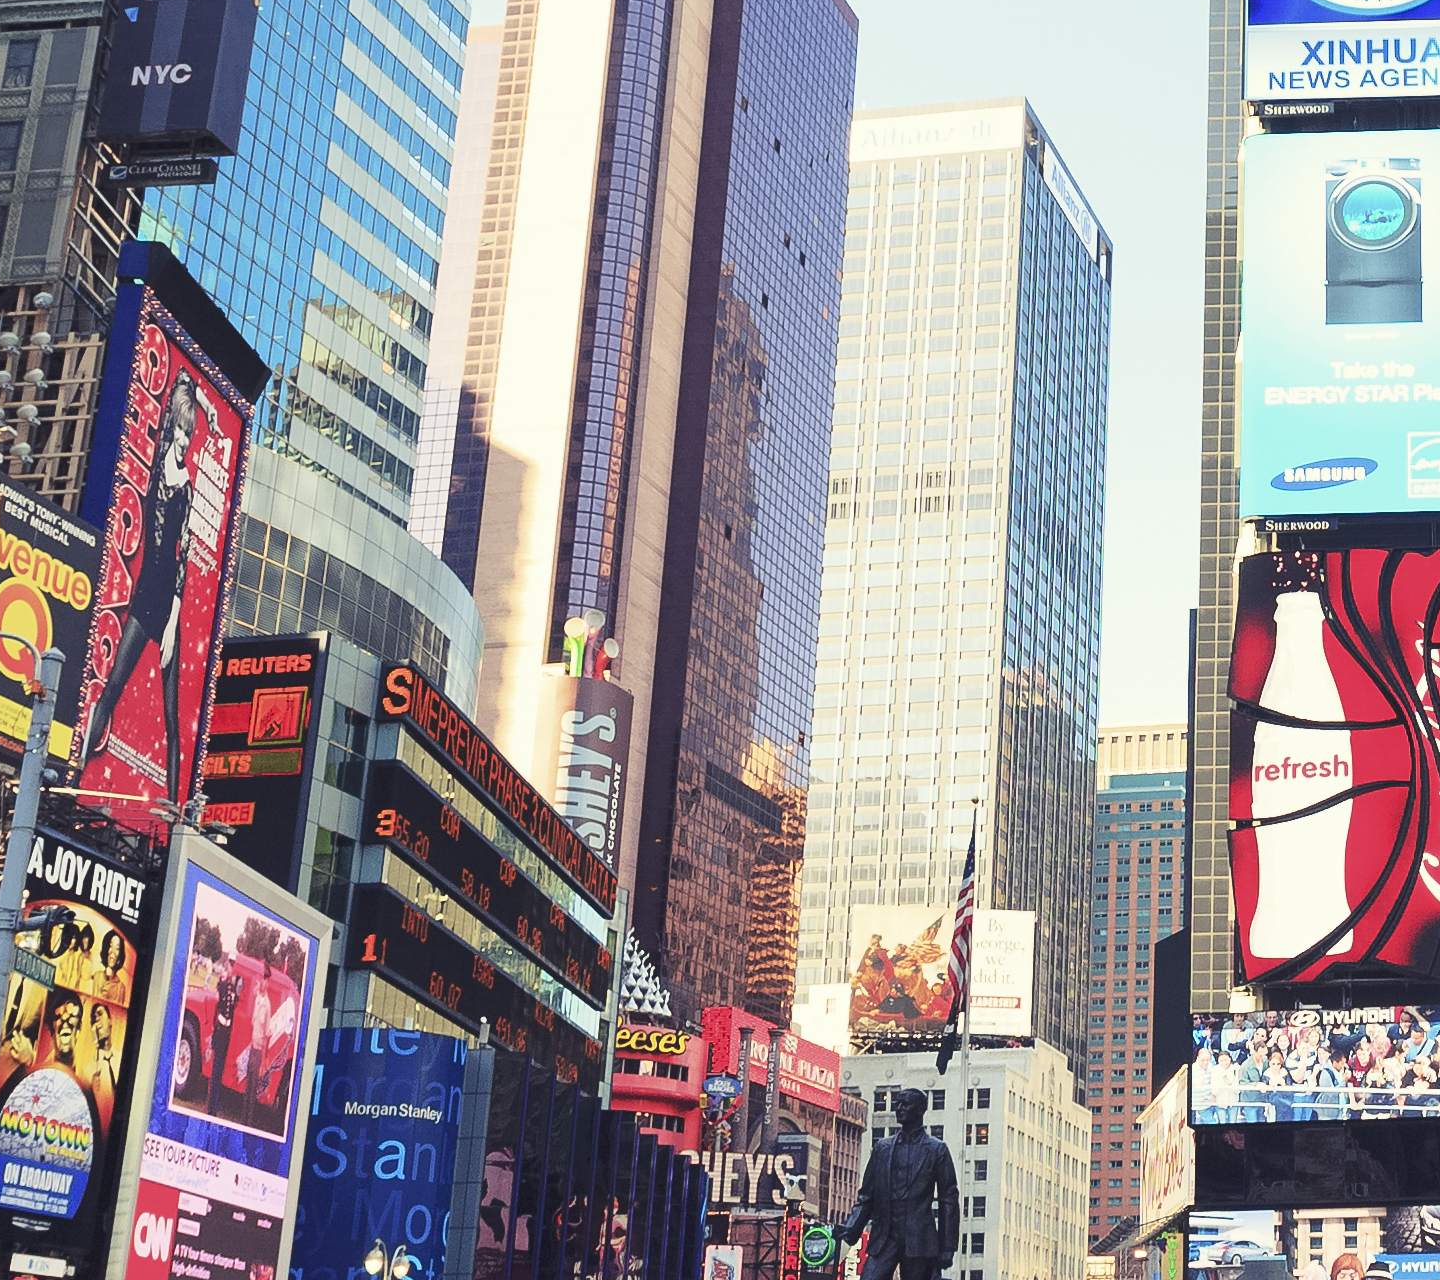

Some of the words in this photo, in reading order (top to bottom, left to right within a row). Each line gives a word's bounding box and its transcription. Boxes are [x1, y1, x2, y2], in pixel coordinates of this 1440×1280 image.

[131, 64, 192, 85] NYC
[1268, 70, 1350, 90] NEWS
[1264, 103, 1329, 115] SHERWOOD
[1330, 361, 1379, 379] Take
[1383, 360, 1415, 378] the
[1264, 385, 1350, 405] ENERGY
[1354, 384, 1409, 403] STAR
[1284, 467, 1366, 483] SAMSUNG
[1265, 520, 1329, 531] SHERWOOD
[227, 654, 311, 676] REUTERS
[1255, 755, 1349, 782] refresh
[383, 667, 487, 784] SIMEPREVIR
[490, 755, 529, 827] PHASE
[530, 796, 539, 833] 3
[539, 805, 582, 881] CLINICAL
[586, 851, 607, 901] DATA
[608, 763, 622, 851] CHOCOLATE
[45, 845, 91, 896] JOY
[1322, 1007, 1396, 1024] HYUNDAI
[345, 1102, 397, 1118] Morgan
[399, 1104, 442, 1124] Stanley
[144, 1138, 160, 1158] SEE
[20, 1165, 73, 1195] BROADWAY
[134, 1213, 173, 1262] CNN
